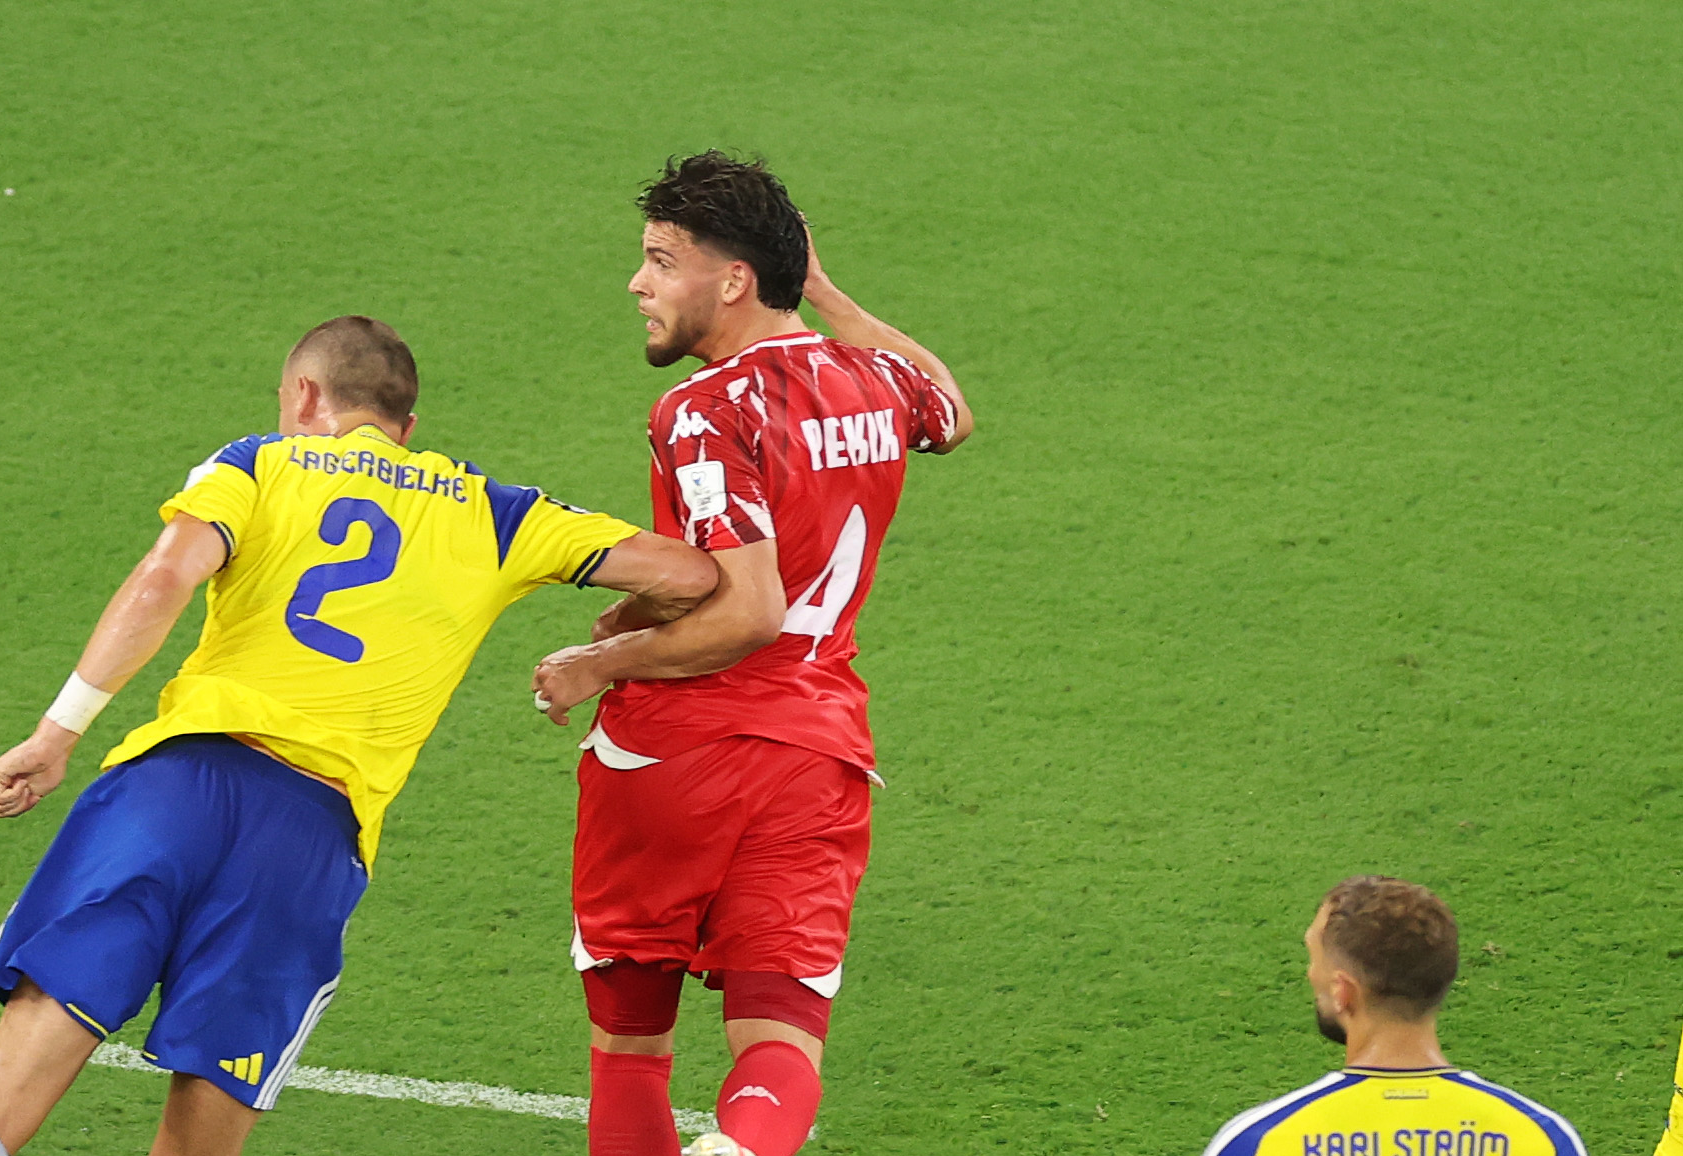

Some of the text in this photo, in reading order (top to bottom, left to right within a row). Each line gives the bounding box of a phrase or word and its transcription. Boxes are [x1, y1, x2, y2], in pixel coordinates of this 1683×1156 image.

[290, 445, 467, 503] LAGERBIELKE
[285, 497, 402, 663] 2
[781, 504, 868, 662] 4
